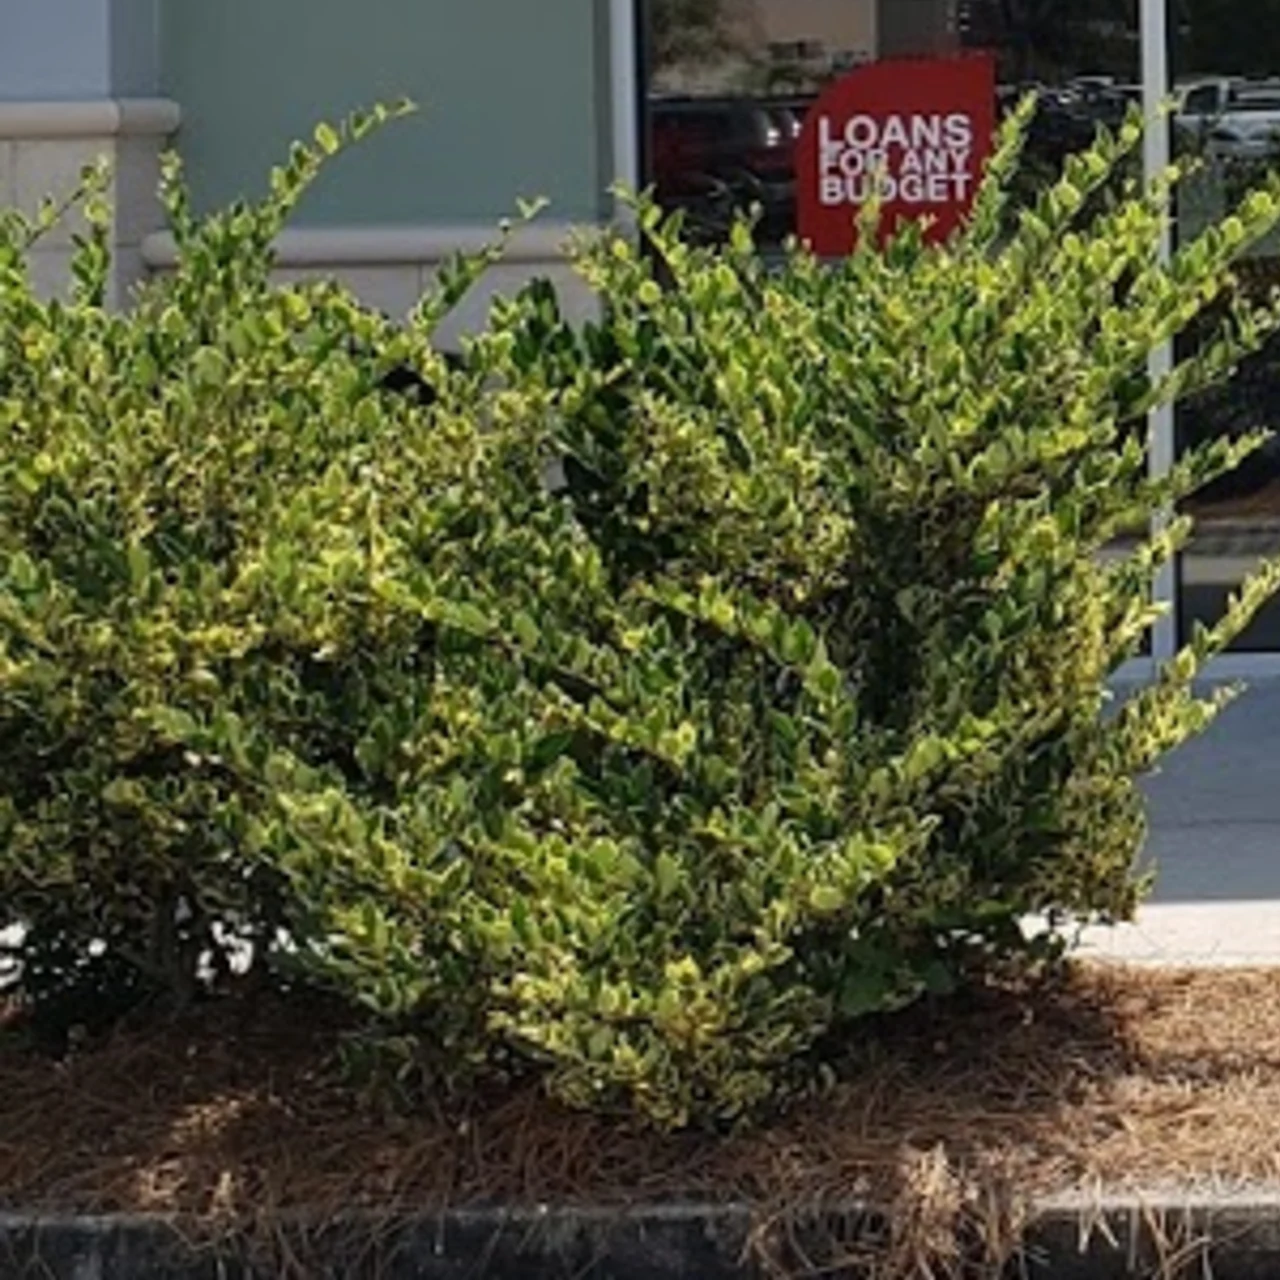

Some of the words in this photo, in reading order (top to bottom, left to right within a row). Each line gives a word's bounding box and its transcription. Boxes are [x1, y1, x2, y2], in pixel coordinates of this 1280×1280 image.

[818, 113, 972, 150] LOANS
[900, 146, 971, 175] ANY
[819, 172, 973, 206] BUDGET
